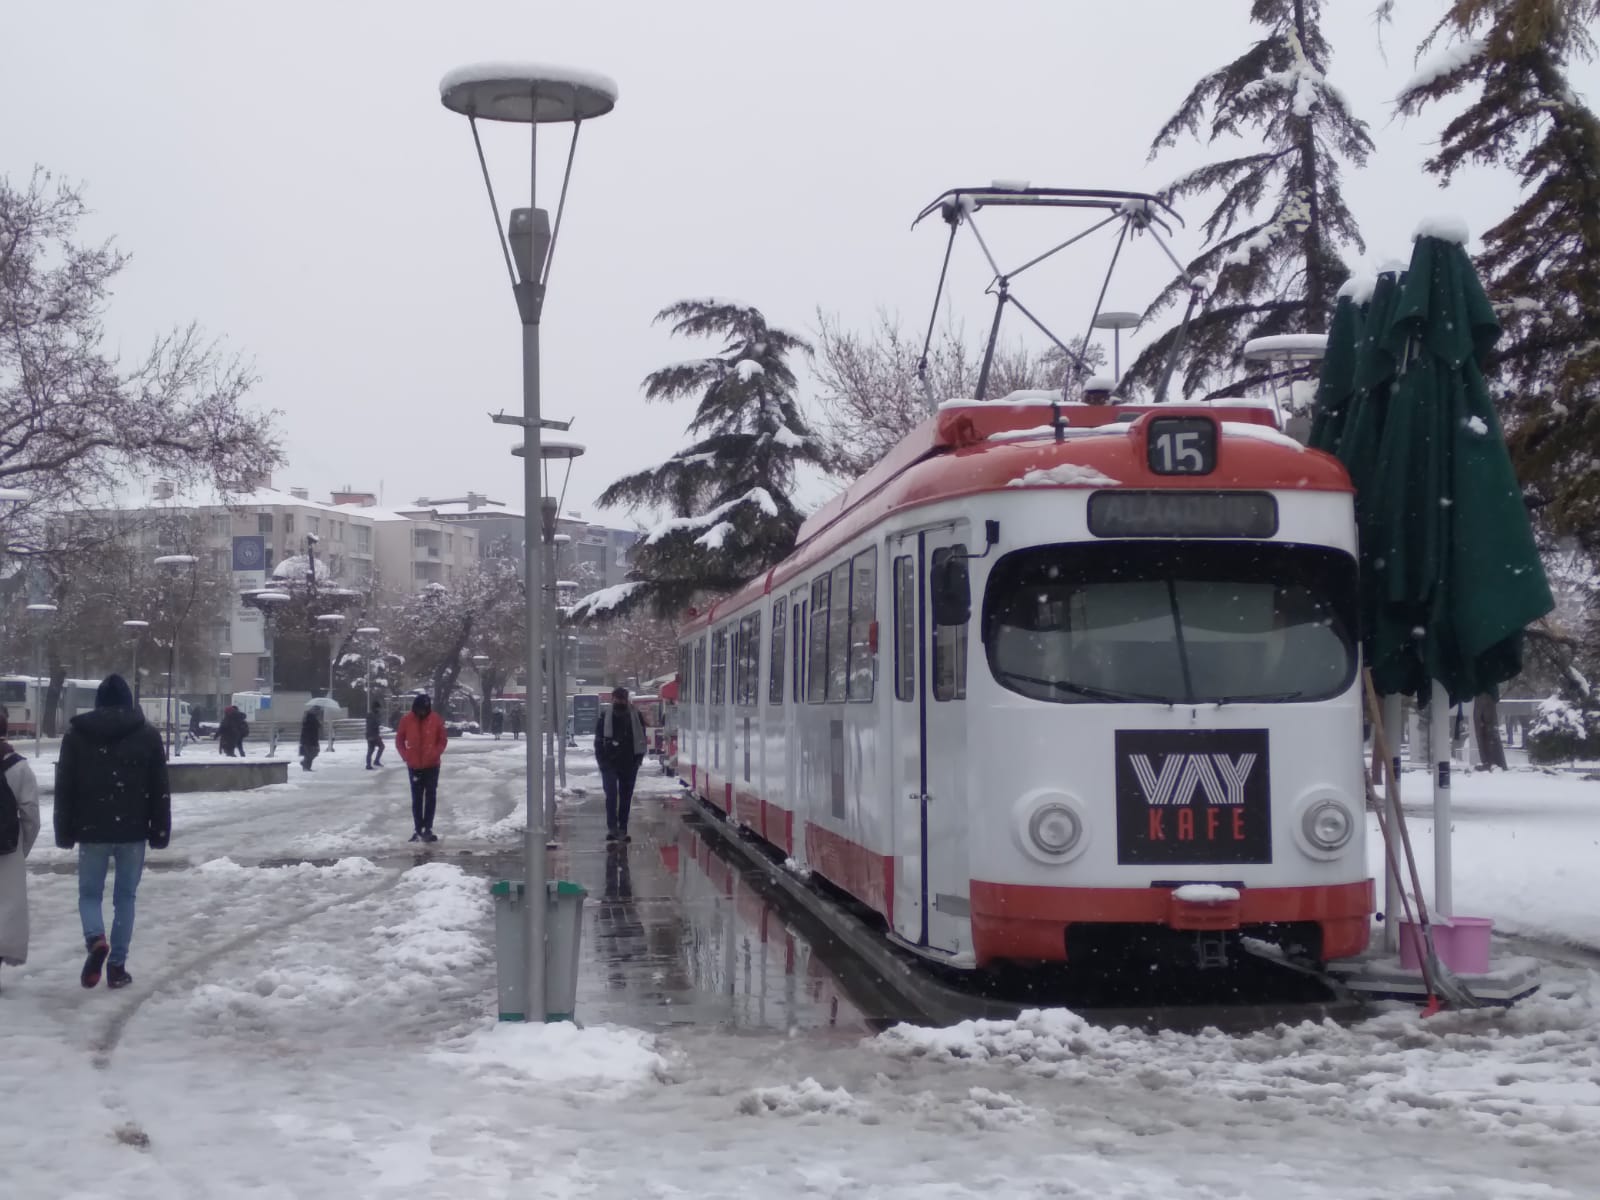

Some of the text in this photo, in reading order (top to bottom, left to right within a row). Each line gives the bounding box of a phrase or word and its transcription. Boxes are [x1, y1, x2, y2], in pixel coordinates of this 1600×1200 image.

[1157, 431, 1204, 472] 15
[1128, 753, 1257, 805] VAY
[1148, 807, 1246, 841] KAFE
